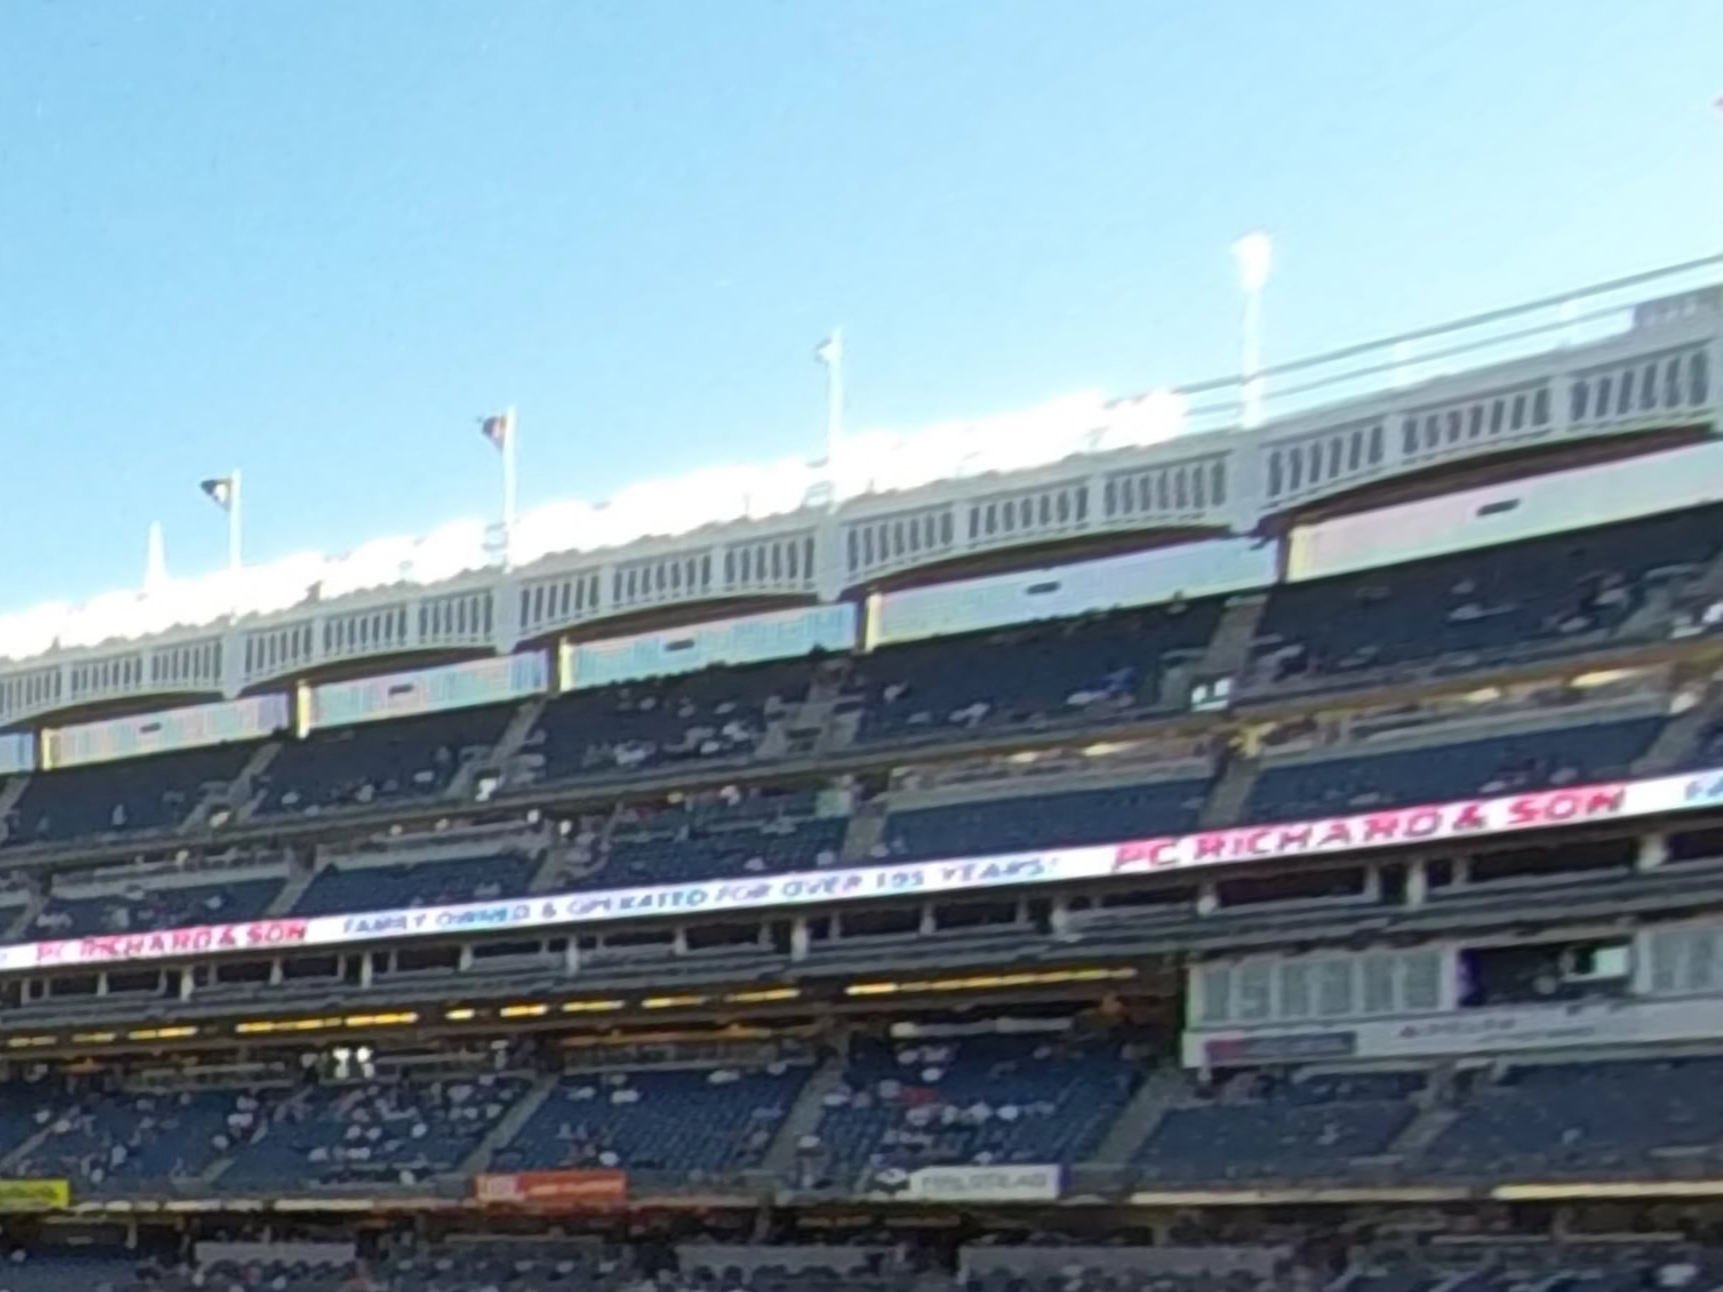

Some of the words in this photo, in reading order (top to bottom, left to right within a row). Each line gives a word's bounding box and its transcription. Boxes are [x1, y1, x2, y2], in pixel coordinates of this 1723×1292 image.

[1111, 838, 1180, 873] PC
[1192, 806, 1442, 860] RICHARD
[1451, 803, 1487, 830] &
[1508, 787, 1626, 825] SON
[342, 911, 427, 934] FAMILY
[435, 904, 530, 928] OWNED
[566, 889, 708, 914] OPERATED
[715, 882, 773, 901] FOR
[782, 874, 863, 897] OVER
[80, 926, 211, 956] RICHARD
[248, 918, 307, 943] SON
